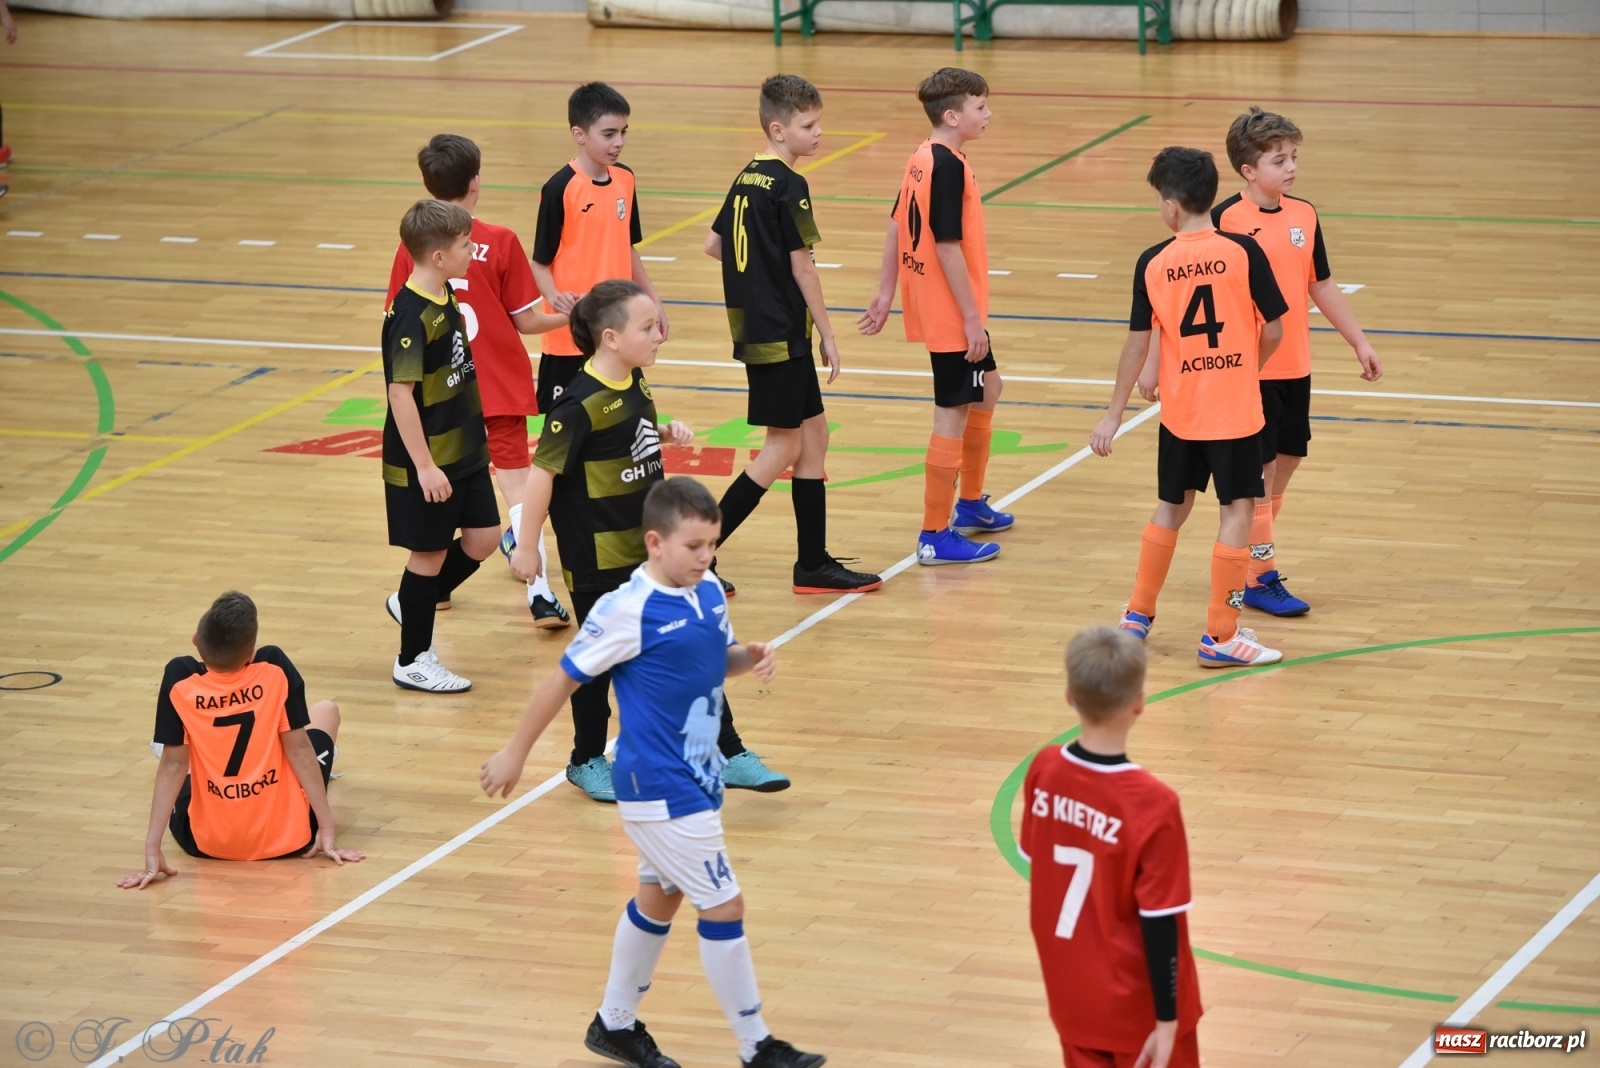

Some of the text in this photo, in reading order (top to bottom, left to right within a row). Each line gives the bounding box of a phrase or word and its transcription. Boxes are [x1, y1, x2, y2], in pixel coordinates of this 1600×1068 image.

[733, 195, 749, 273] 16
[1166, 260, 1227, 282] RAFAKO
[1179, 283, 1225, 349] 4
[446, 370, 461, 387] GH
[608, 398, 623, 411] VIGO
[620, 463, 646, 483] GH
[195, 684, 264, 710] RAFAKO
[212, 710, 256, 778] 7
[1053, 794, 1122, 845] KIETRZ
[703, 851, 733, 890] 14
[1053, 843, 1095, 940] 7
